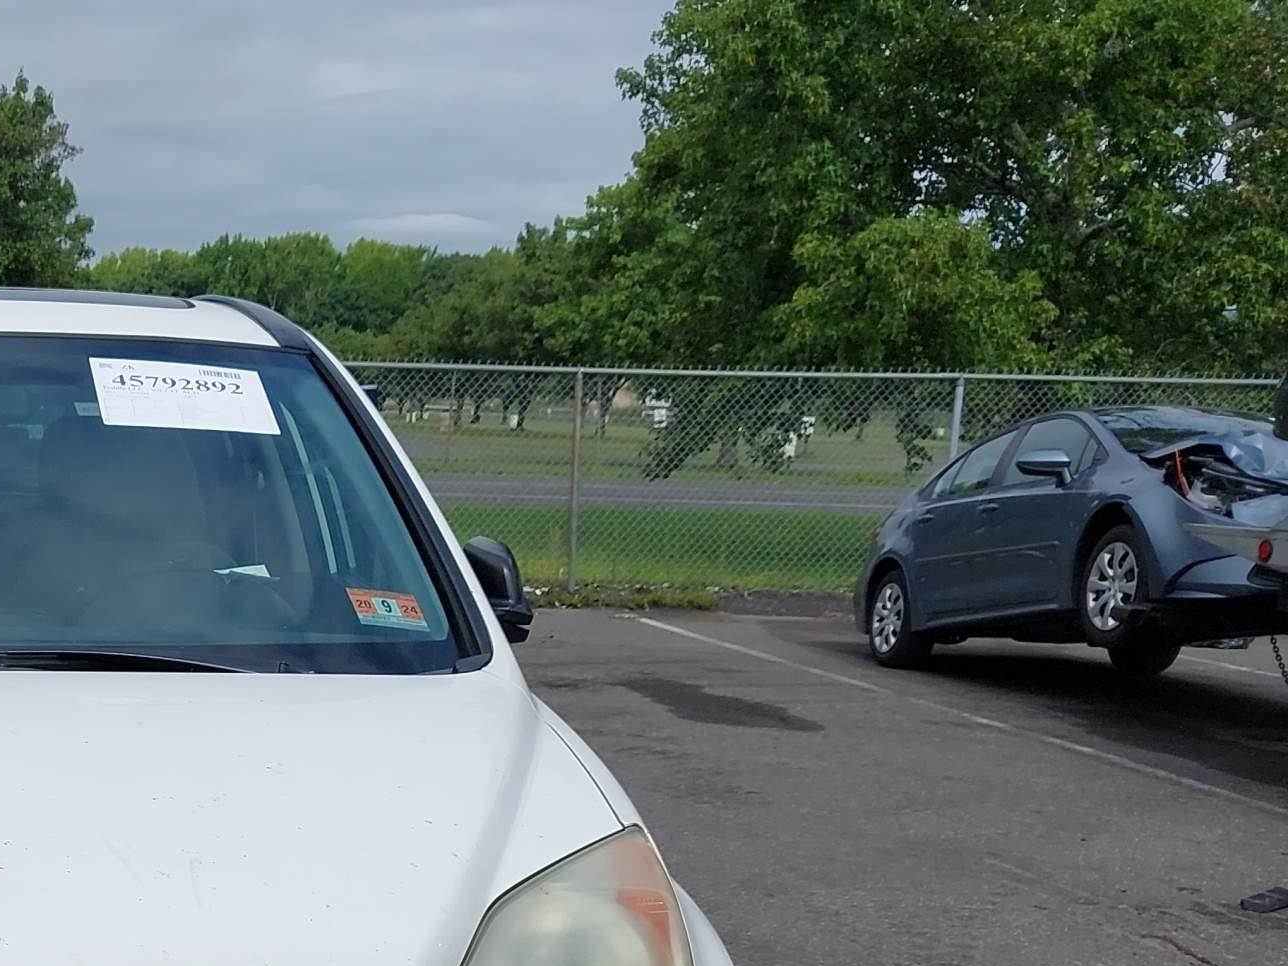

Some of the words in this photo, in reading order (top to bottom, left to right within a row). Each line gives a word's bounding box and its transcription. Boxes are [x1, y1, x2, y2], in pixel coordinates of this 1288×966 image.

[112, 374, 244, 395] 45792892
[356, 599, 372, 609] 20
[381, 600, 392, 613] 9
